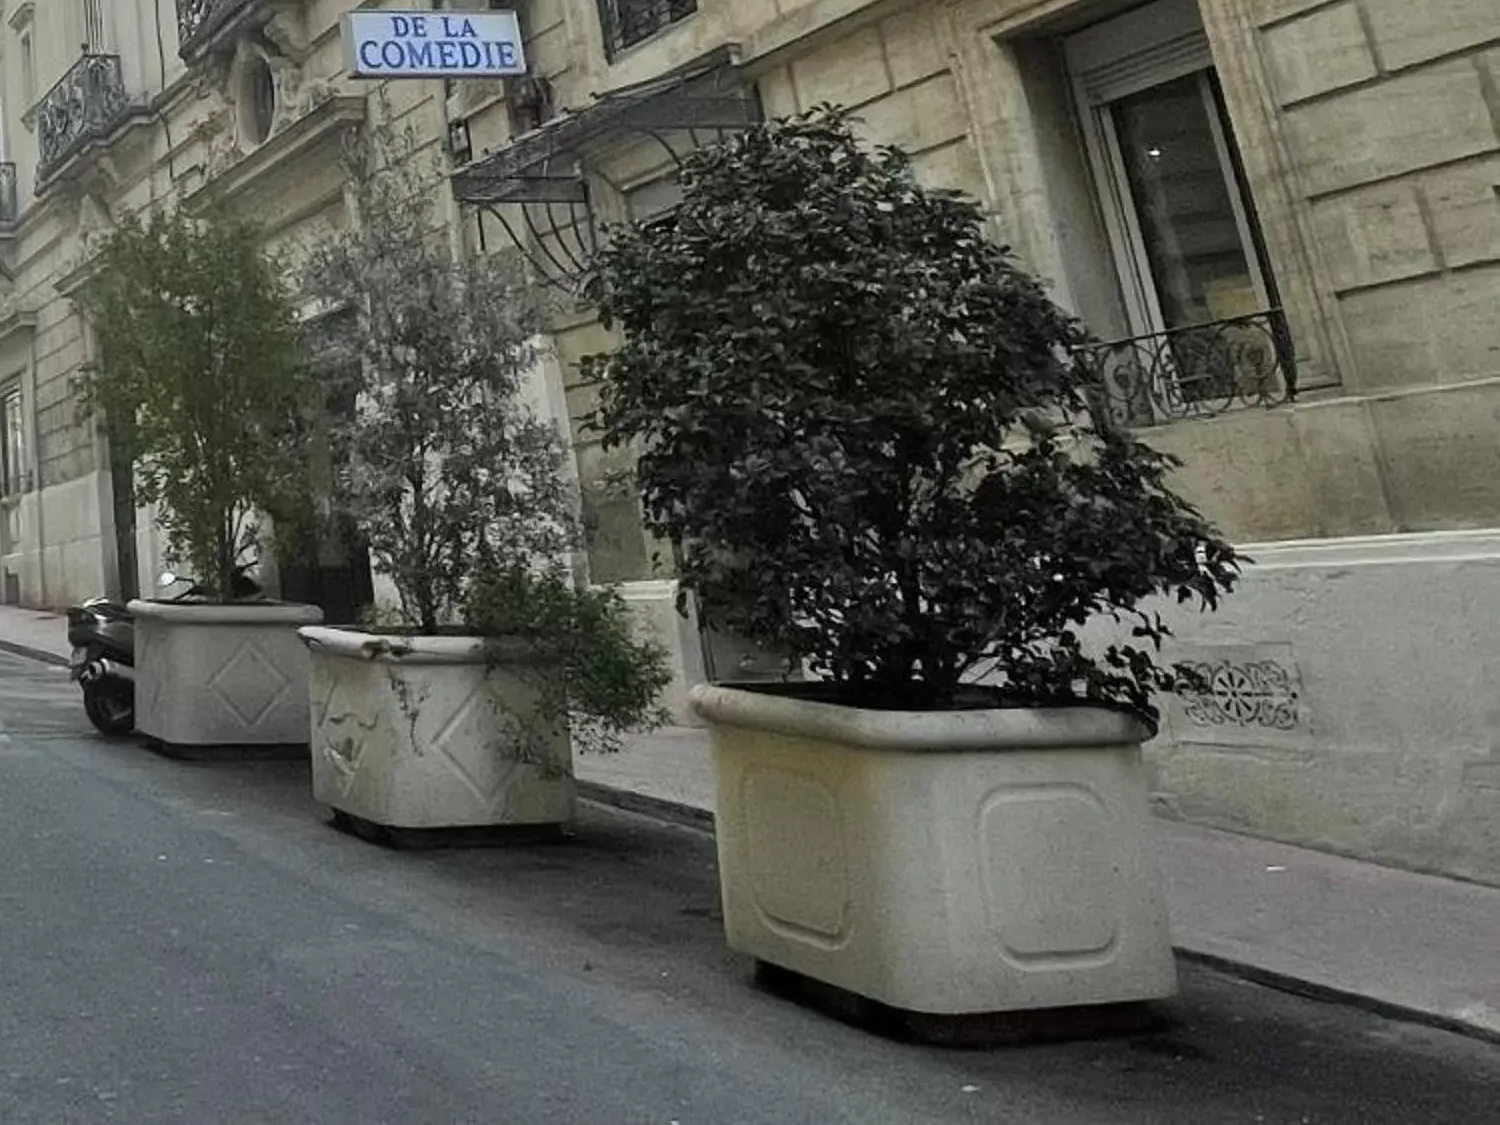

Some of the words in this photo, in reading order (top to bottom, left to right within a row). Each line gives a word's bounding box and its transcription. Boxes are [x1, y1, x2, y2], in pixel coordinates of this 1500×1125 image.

[390, 16, 427, 38] DE
[441, 16, 478, 38] LA
[359, 40, 518, 69] COMEDIE
